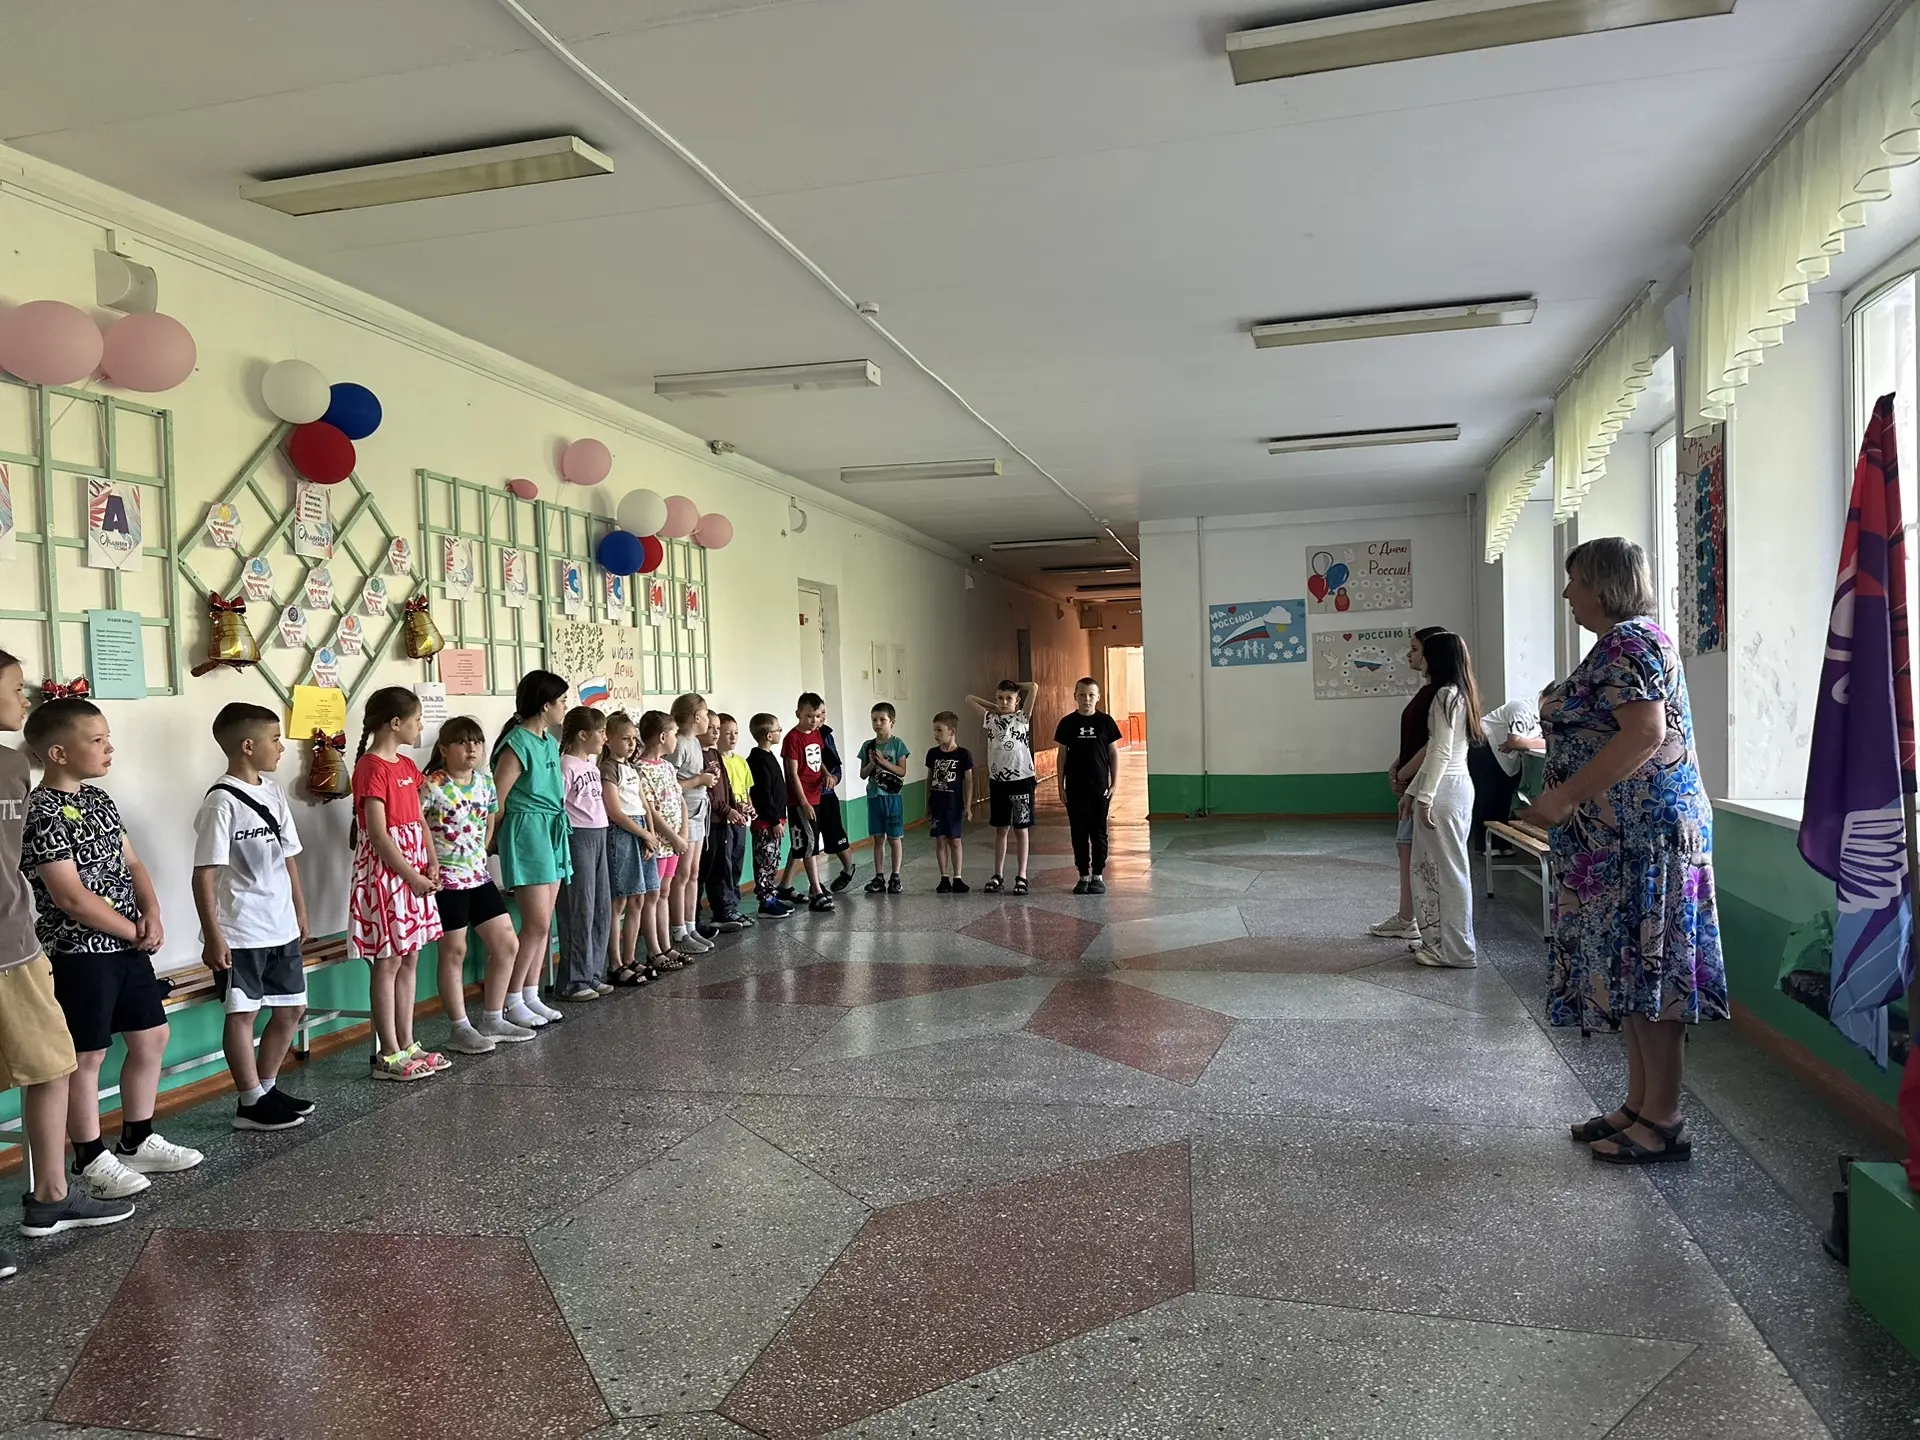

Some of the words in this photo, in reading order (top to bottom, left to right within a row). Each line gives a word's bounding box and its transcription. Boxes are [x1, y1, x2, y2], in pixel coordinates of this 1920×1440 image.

[102, 495, 129, 534] А
[1368, 543, 1377, 555] С
[1369, 559, 1411, 575] России!
[617, 628, 626, 644] 12
[607, 678, 640, 701] России!
